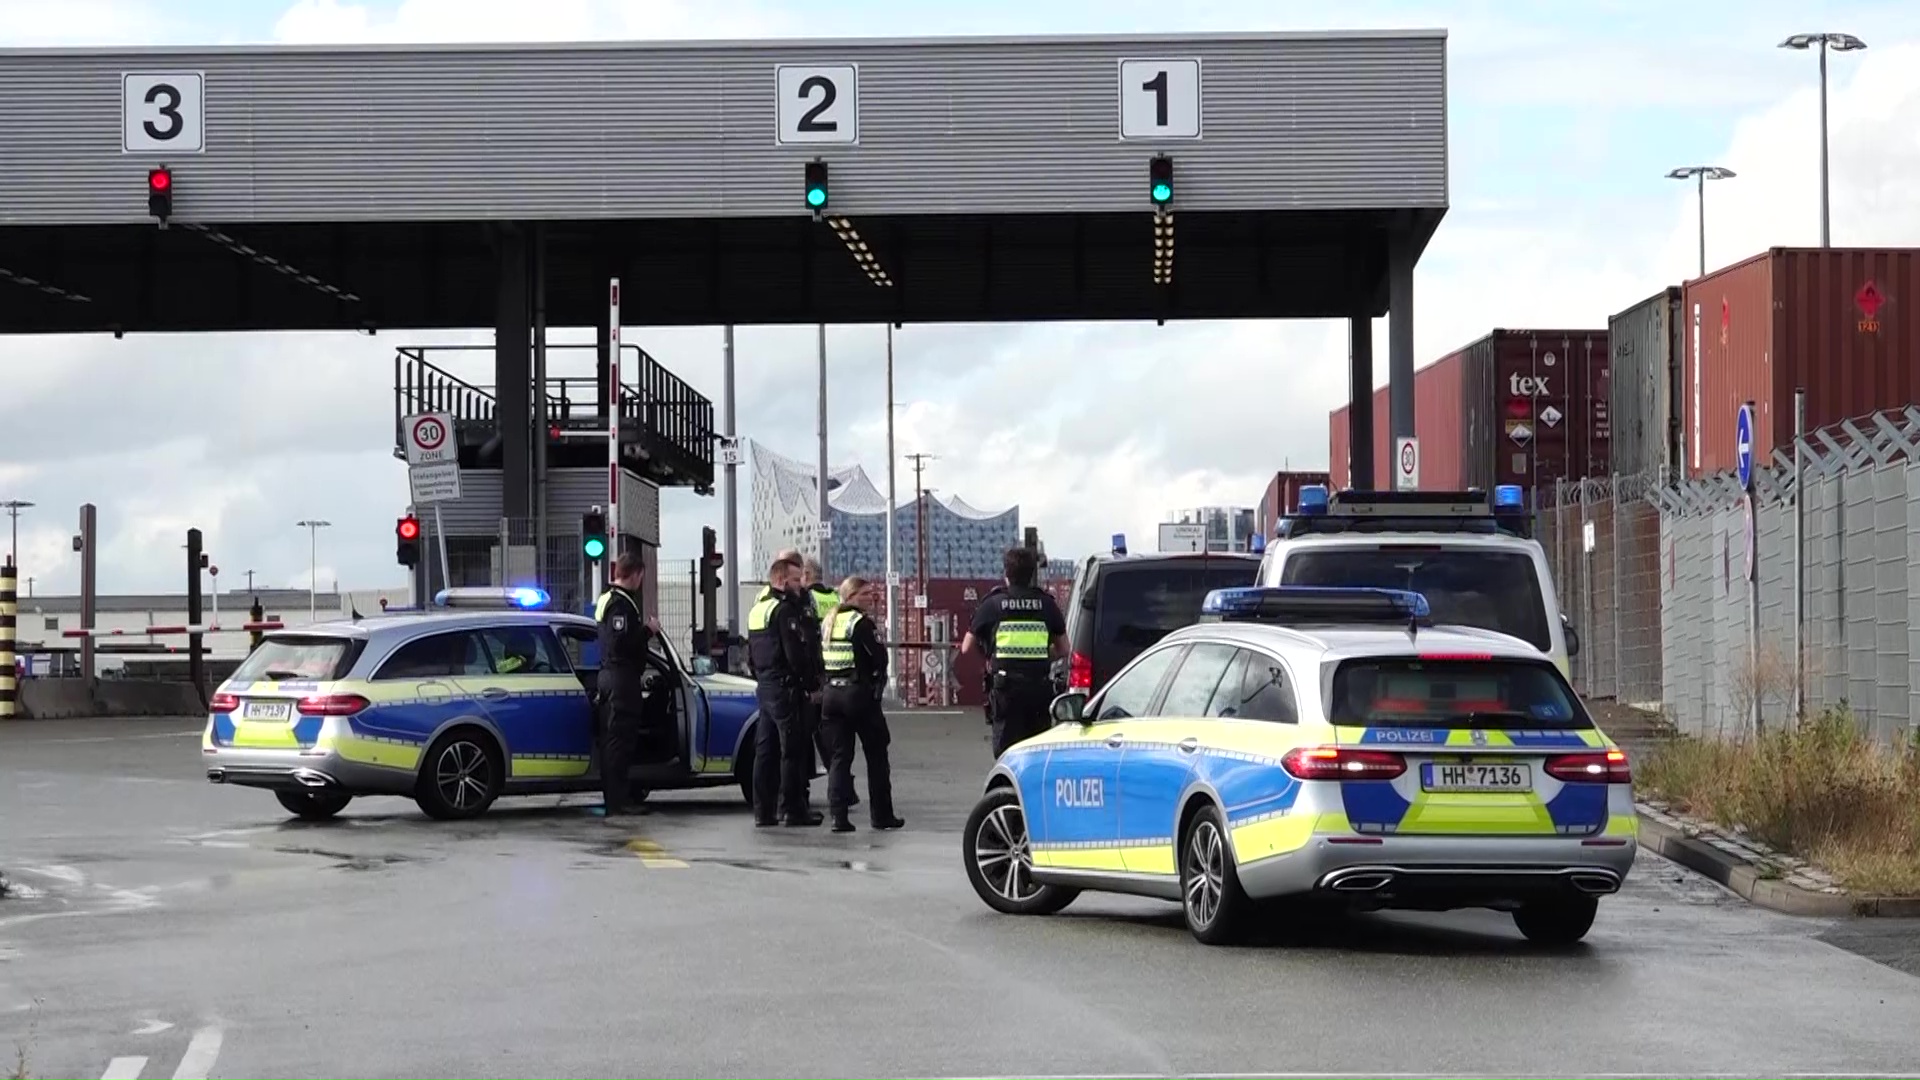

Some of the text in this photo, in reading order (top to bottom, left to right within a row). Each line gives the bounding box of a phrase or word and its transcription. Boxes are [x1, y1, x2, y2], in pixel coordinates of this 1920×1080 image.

[797, 75, 837, 132] 2
[1142, 71, 1168, 126] 1
[143, 83, 183, 141] 3
[1509, 372, 1550, 396] tex
[420, 426, 439, 441] 30
[724, 451, 736, 461] 15
[1001, 599, 1042, 610] POLIZEI
[251, 704, 286, 716] HH 7139
[1376, 730, 1434, 743] POLIZEI
[1442, 766, 1521, 786] HH 7136
[1055, 778, 1104, 808] POLIZEI
